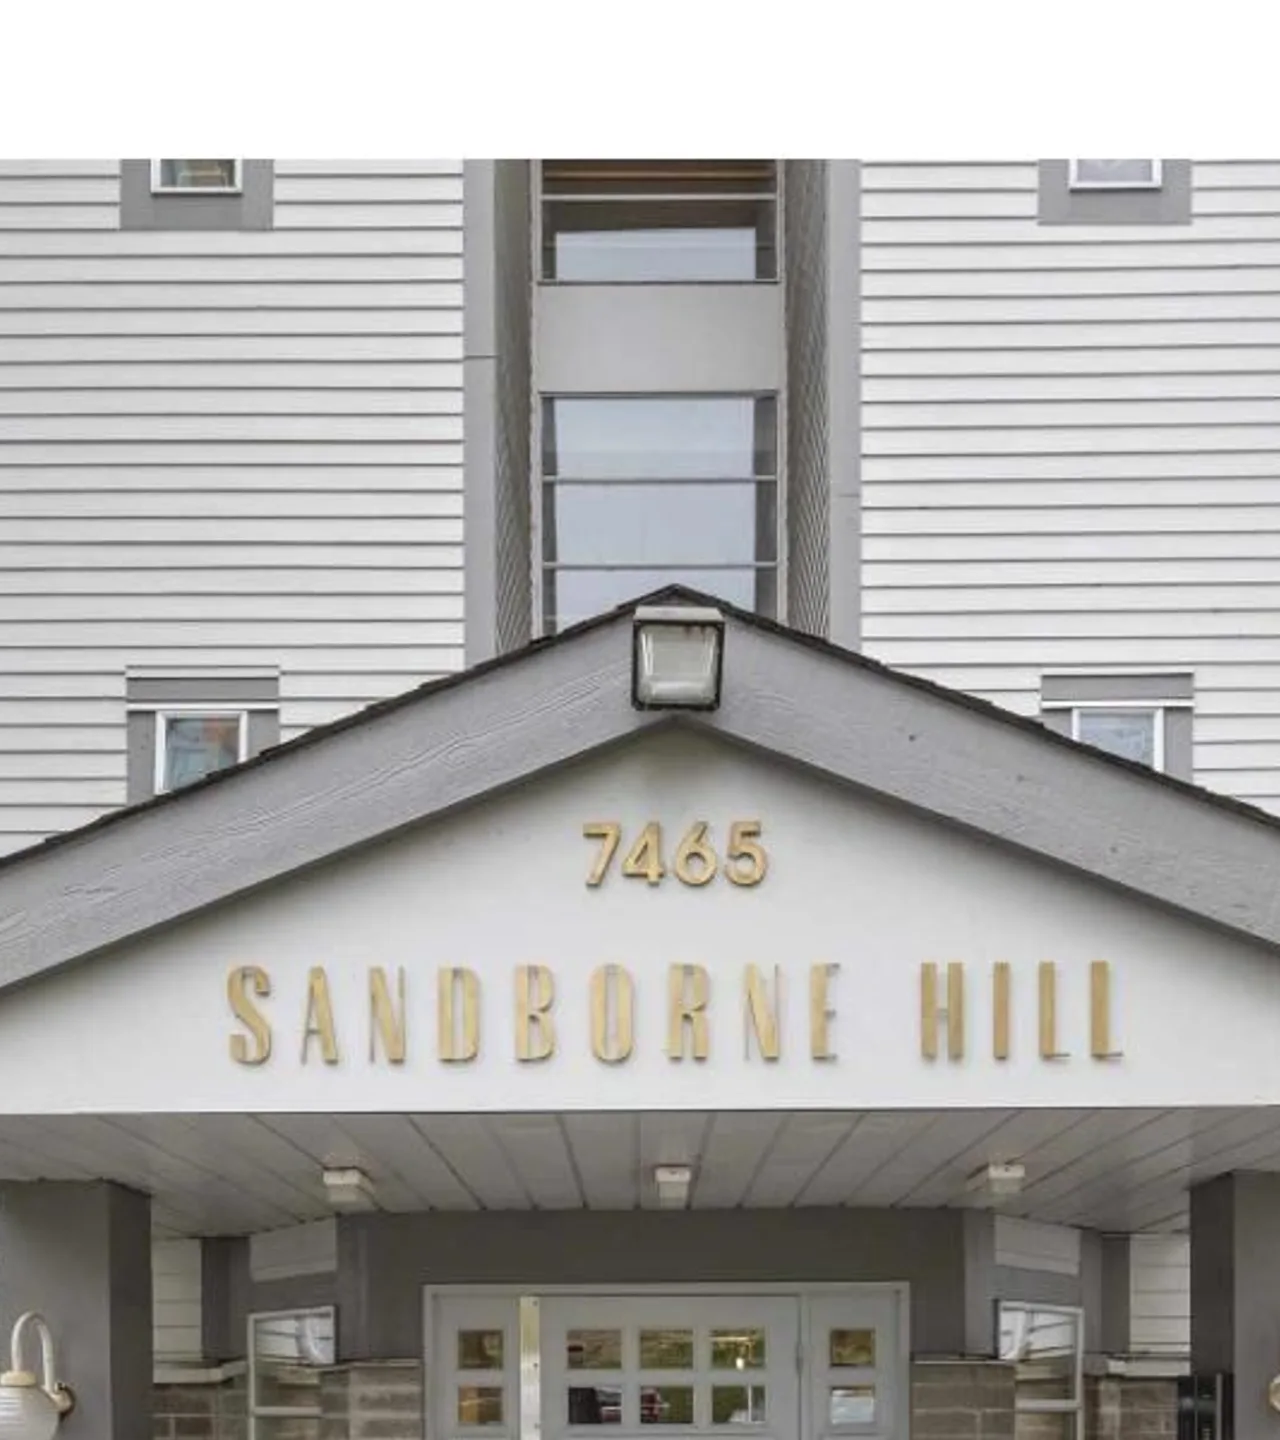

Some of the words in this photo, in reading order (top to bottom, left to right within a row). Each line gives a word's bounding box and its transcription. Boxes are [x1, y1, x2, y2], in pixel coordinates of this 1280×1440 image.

[580, 818, 770, 889] 7465
[224, 961, 841, 1066] SANDBORNE
[917, 959, 1125, 1064] HILL
